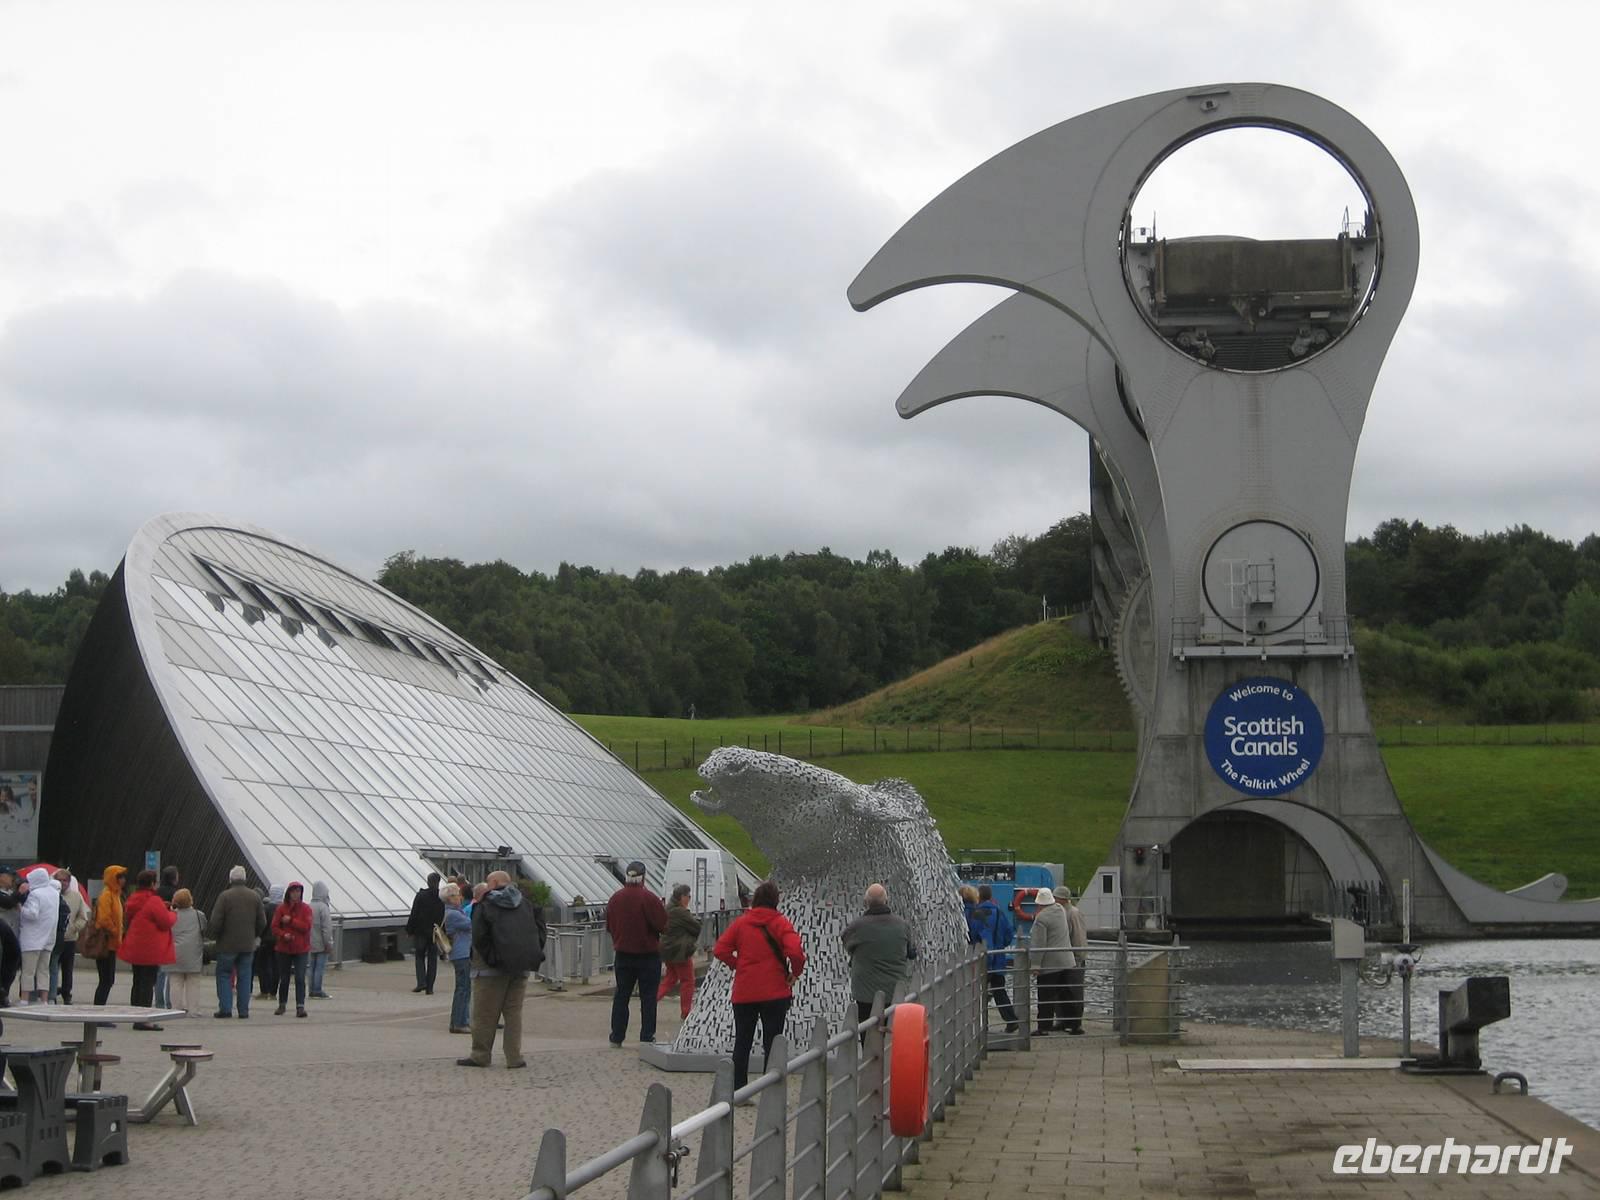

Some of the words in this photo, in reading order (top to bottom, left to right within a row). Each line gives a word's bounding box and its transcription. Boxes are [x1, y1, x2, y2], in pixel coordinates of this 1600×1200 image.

[1229, 685, 1280, 702] Welcome
[1282, 689, 1294, 701] to
[1224, 715, 1304, 736] Scottish
[1230, 736, 1298, 756] Canals
[1220, 759, 1238, 780] The
[1239, 774, 1278, 790] Falkirk
[1279, 758, 1311, 786] Wheel
